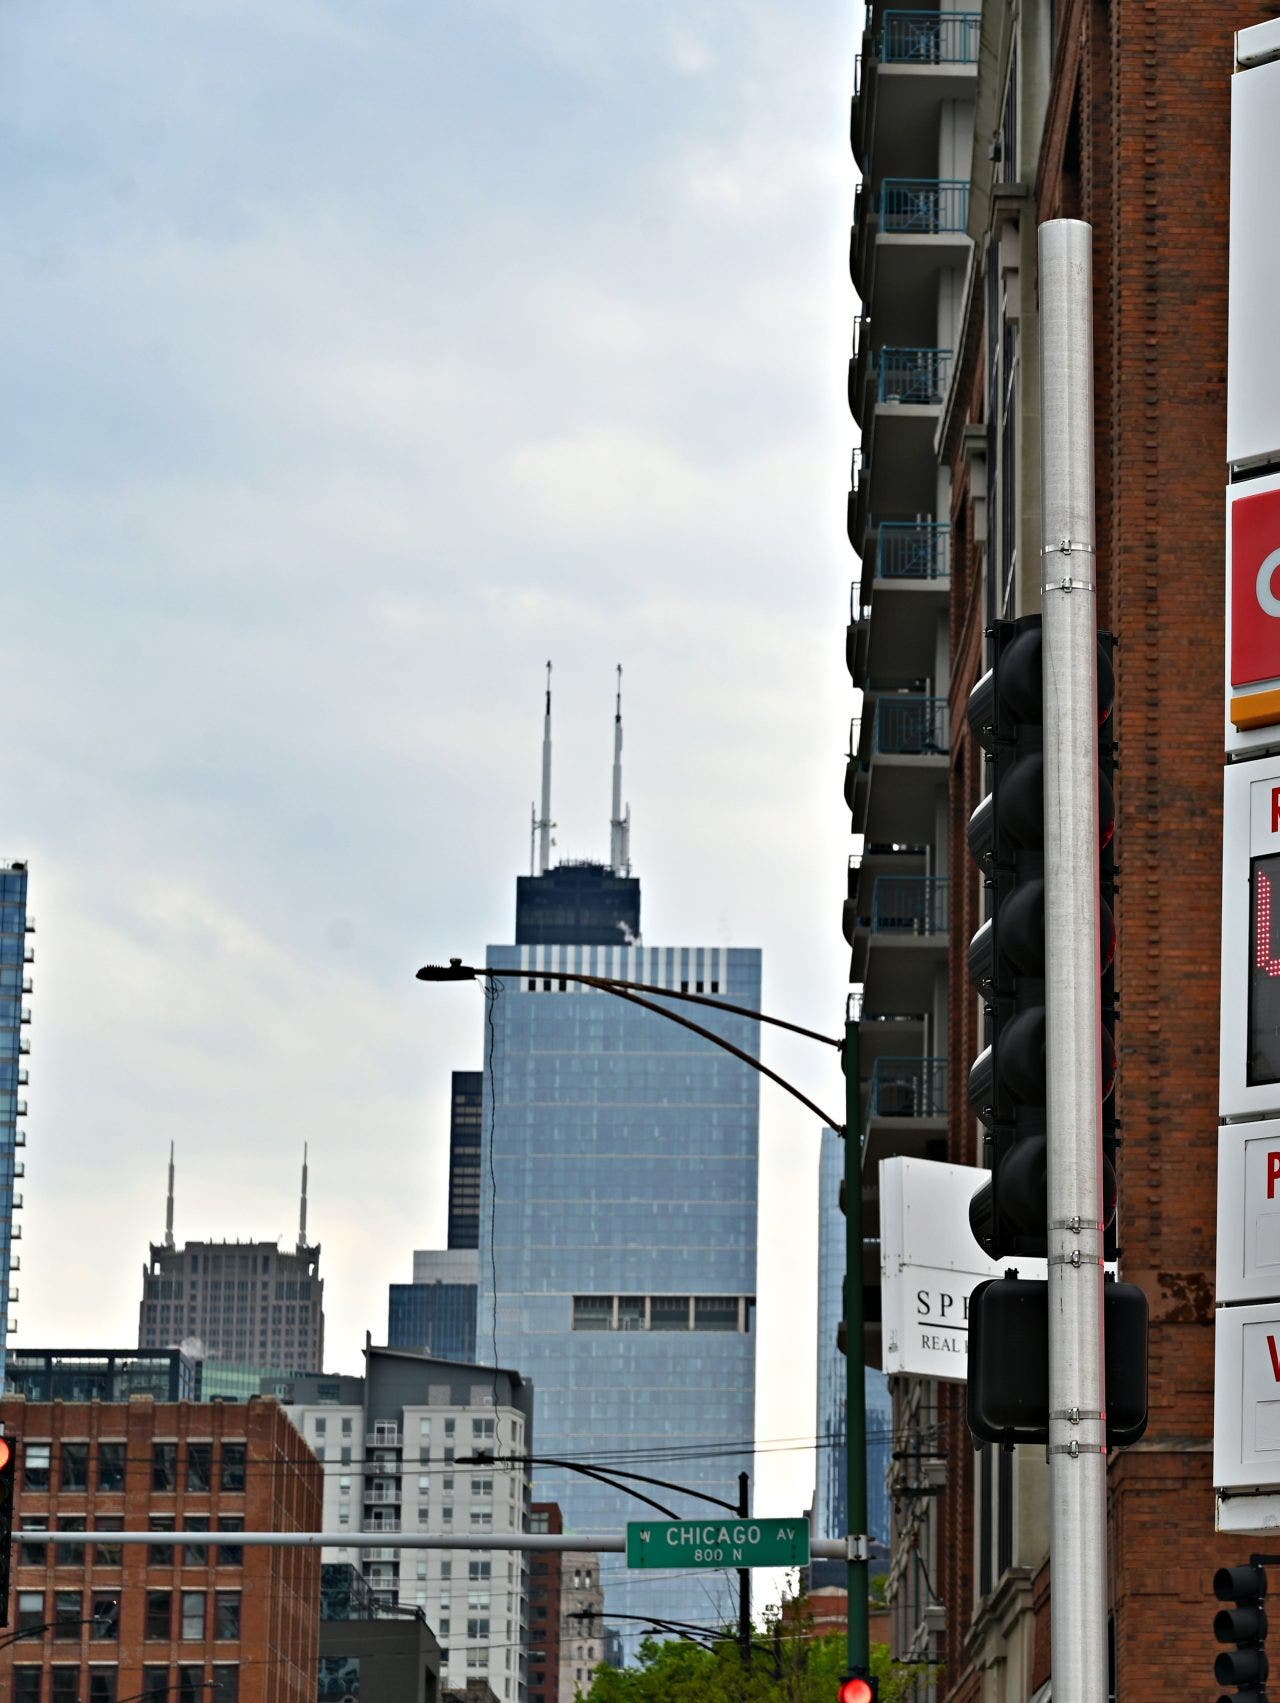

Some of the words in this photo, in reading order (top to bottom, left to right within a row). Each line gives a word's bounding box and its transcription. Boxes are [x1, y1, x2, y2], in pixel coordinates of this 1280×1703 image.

[921, 1334, 960, 1353] REAL
[640, 1530, 651, 1543] W
[666, 1526, 761, 1546] CHICAGO
[776, 1528, 796, 1541] AV
[694, 1549, 724, 1562] 800
[732, 1549, 743, 1561] N
